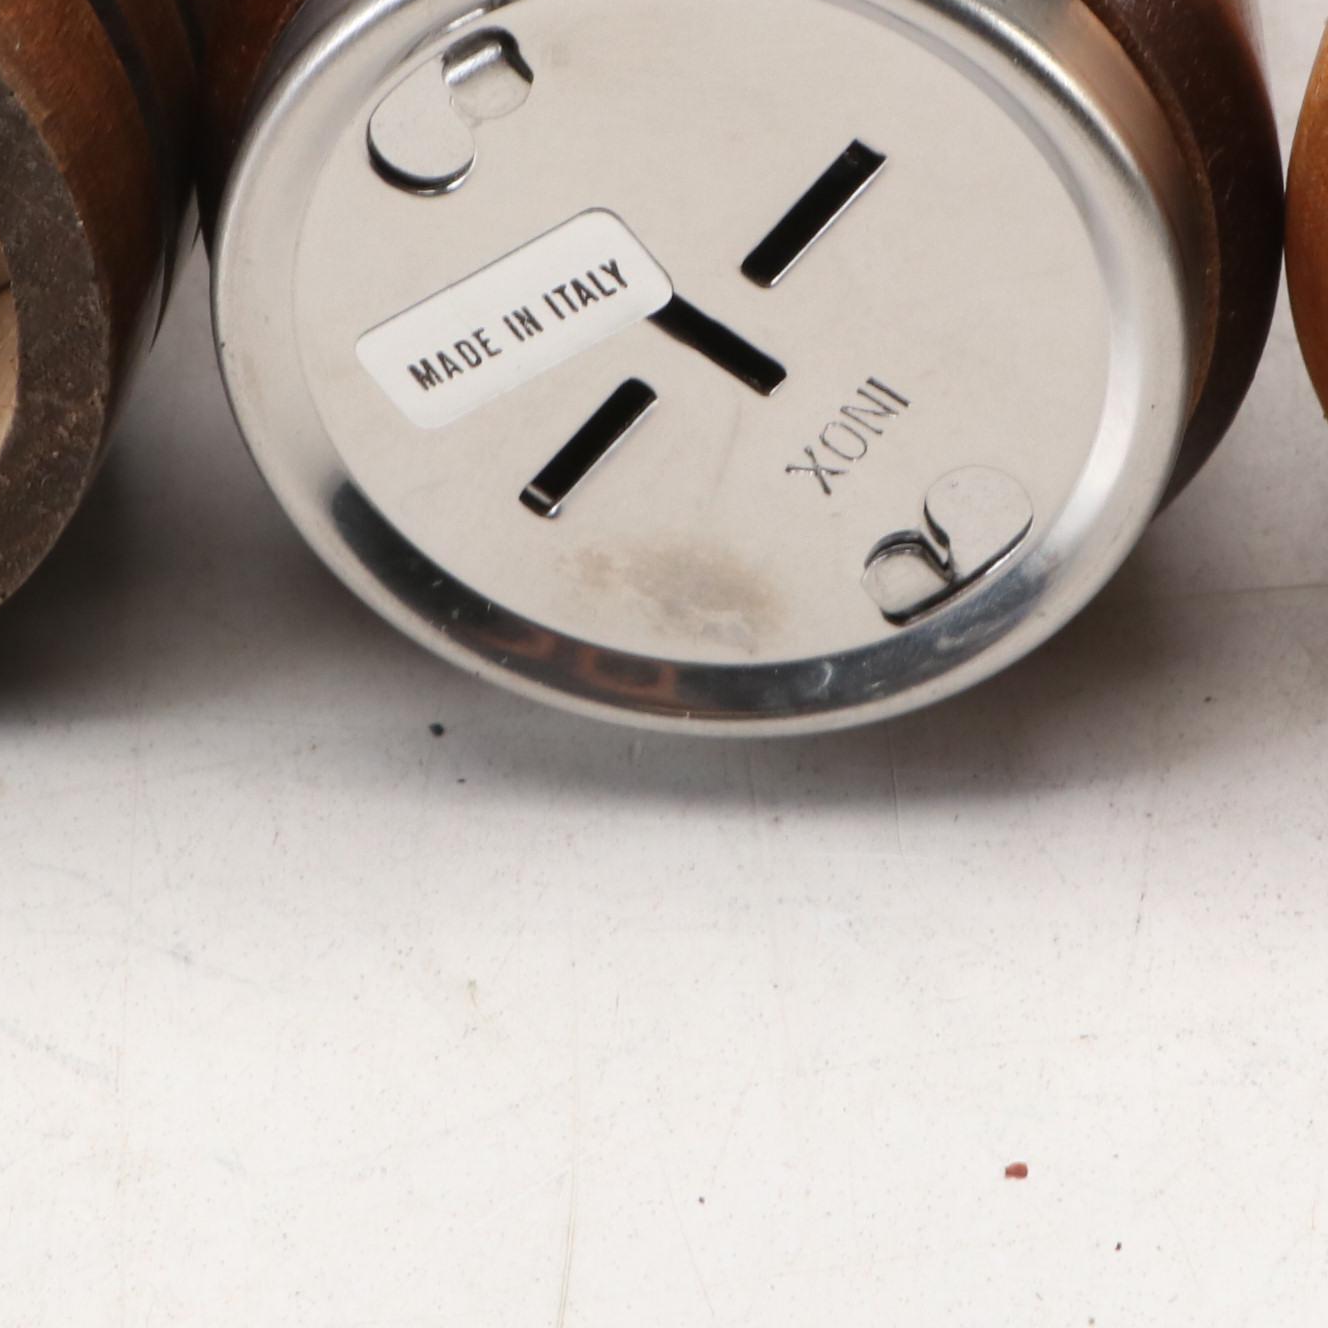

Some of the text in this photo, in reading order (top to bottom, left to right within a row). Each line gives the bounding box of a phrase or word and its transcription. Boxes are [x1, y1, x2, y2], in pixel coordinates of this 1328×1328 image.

[407, 258, 629, 392] MADE IN ITALY
[784, 376, 912, 496] INOX
